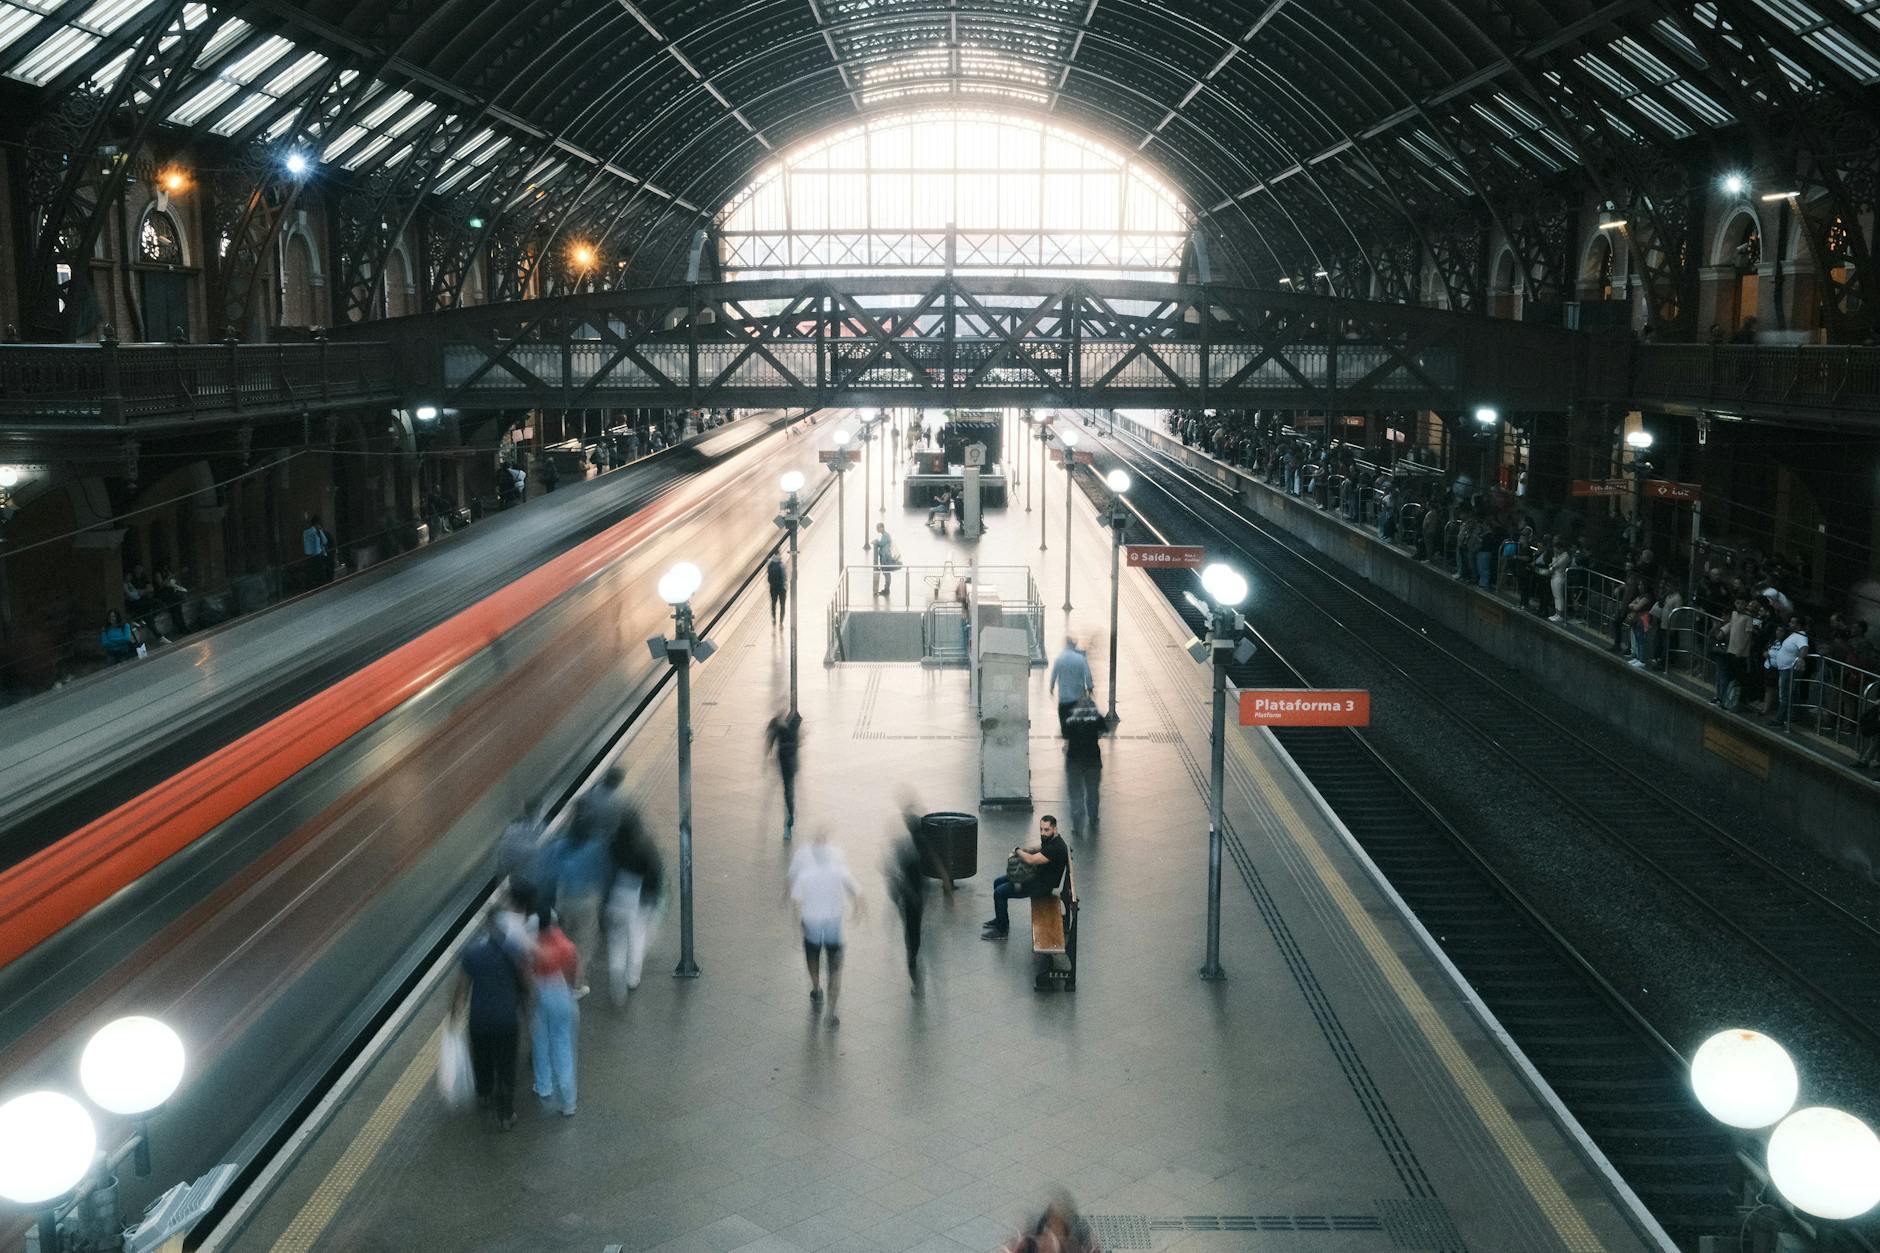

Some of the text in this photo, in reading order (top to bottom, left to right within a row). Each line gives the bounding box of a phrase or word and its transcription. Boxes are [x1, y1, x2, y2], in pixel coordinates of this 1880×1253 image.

[1141, 552, 1171, 562] Saída
[1255, 698, 1355, 712] Plataforma 3
[1255, 711, 1282, 719] Platform
